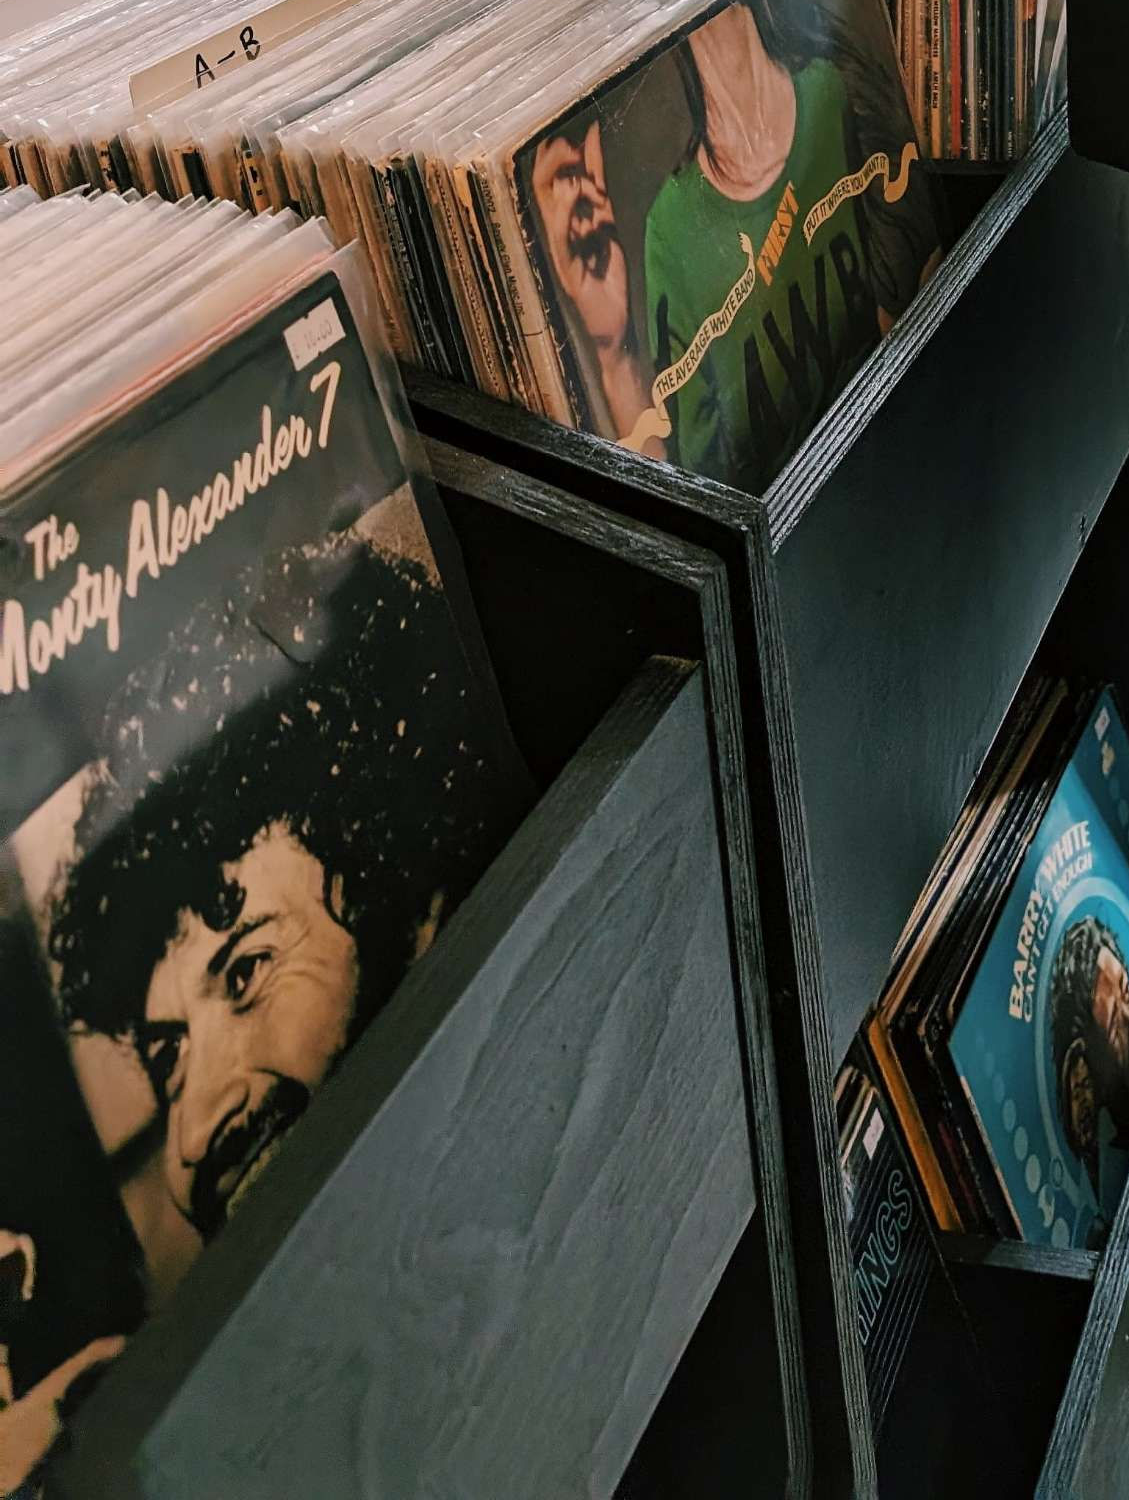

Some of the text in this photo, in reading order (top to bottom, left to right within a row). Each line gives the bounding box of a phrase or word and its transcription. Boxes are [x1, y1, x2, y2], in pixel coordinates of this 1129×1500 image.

[195, 26, 261, 89] A-B
[806, 155, 887, 237] PUT IT WHERE YOU WANT IT
[656, 268, 754, 397] THE AVERAGE WHITE BAND
[0, 361, 342, 695] Monty Alexander 7
[24, 515, 80, 581] The
[1008, 819, 1092, 1020] BARRY WHITE
[851, 1169, 913, 1346] INGS
